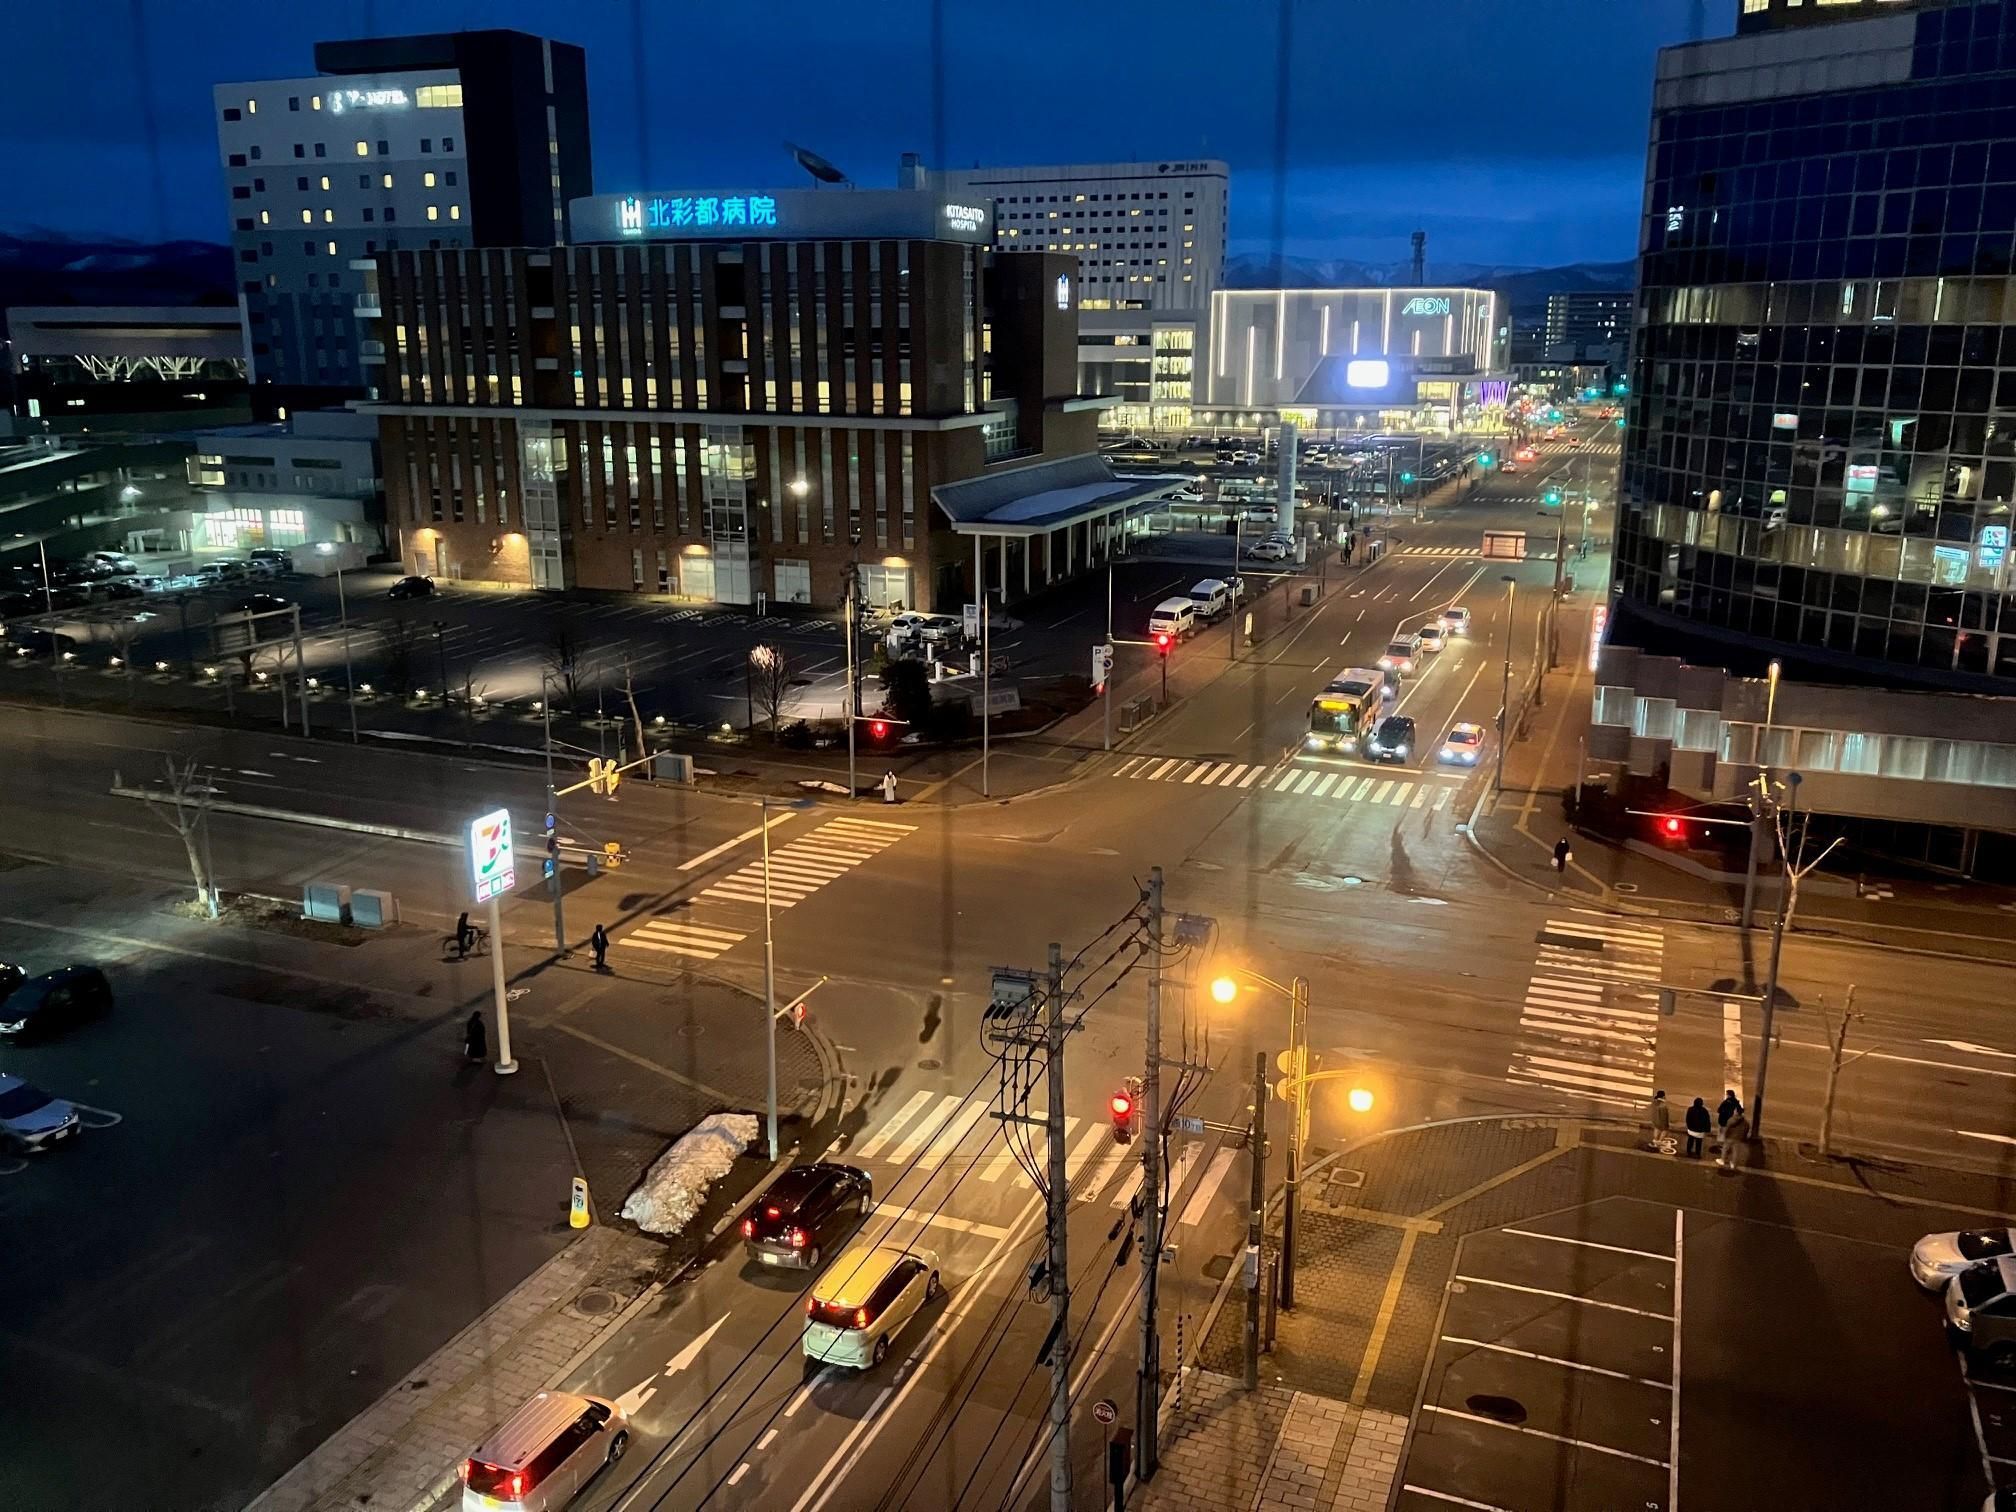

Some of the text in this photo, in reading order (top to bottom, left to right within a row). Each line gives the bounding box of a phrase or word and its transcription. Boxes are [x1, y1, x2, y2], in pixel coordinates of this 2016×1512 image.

[648, 196, 776, 227] 北彩都病院
[946, 204, 984, 222] KITASAITO
[1646, 1501, 1659, 1511] 5
